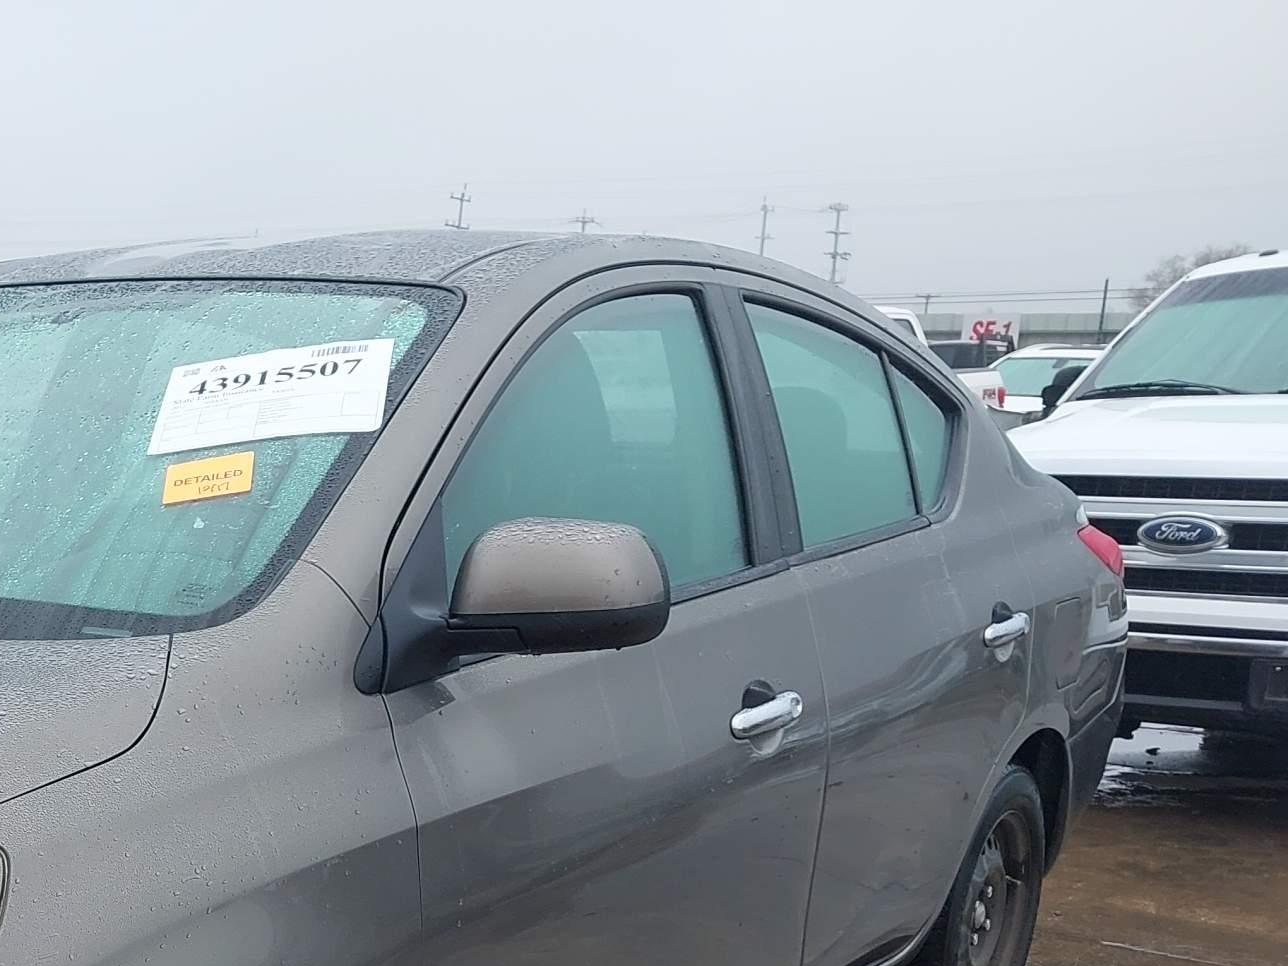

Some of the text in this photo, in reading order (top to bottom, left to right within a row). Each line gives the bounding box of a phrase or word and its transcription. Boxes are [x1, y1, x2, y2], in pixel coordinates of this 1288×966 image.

[188, 358, 364, 395] 43915507
[173, 469, 244, 487] DETAILED
[1155, 522, 1202, 541] Ford
